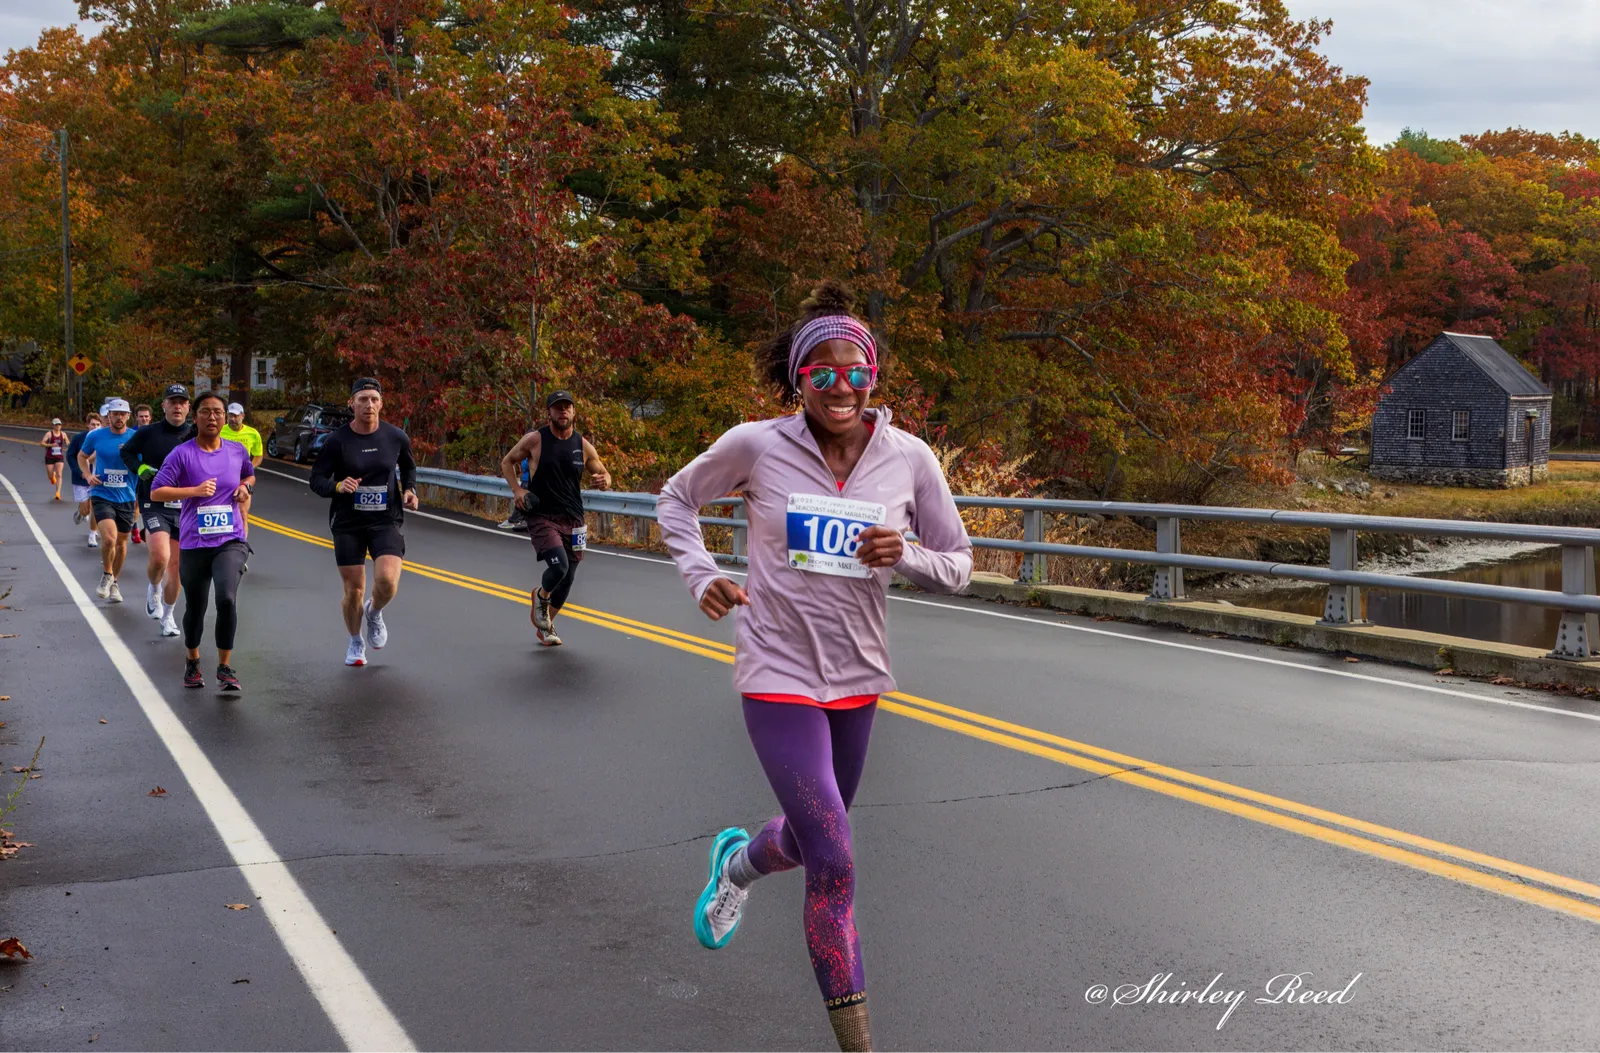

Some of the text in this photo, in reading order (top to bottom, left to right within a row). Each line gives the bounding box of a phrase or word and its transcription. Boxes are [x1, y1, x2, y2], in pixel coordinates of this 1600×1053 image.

[107, 474, 124, 483] 893
[360, 493, 383, 505] 629
[795, 505, 879, 521] SEACOAST HALF MARATHON
[203, 513, 229, 527] 979
[804, 516, 867, 558] 108
[837, 561, 853, 570] M&T
